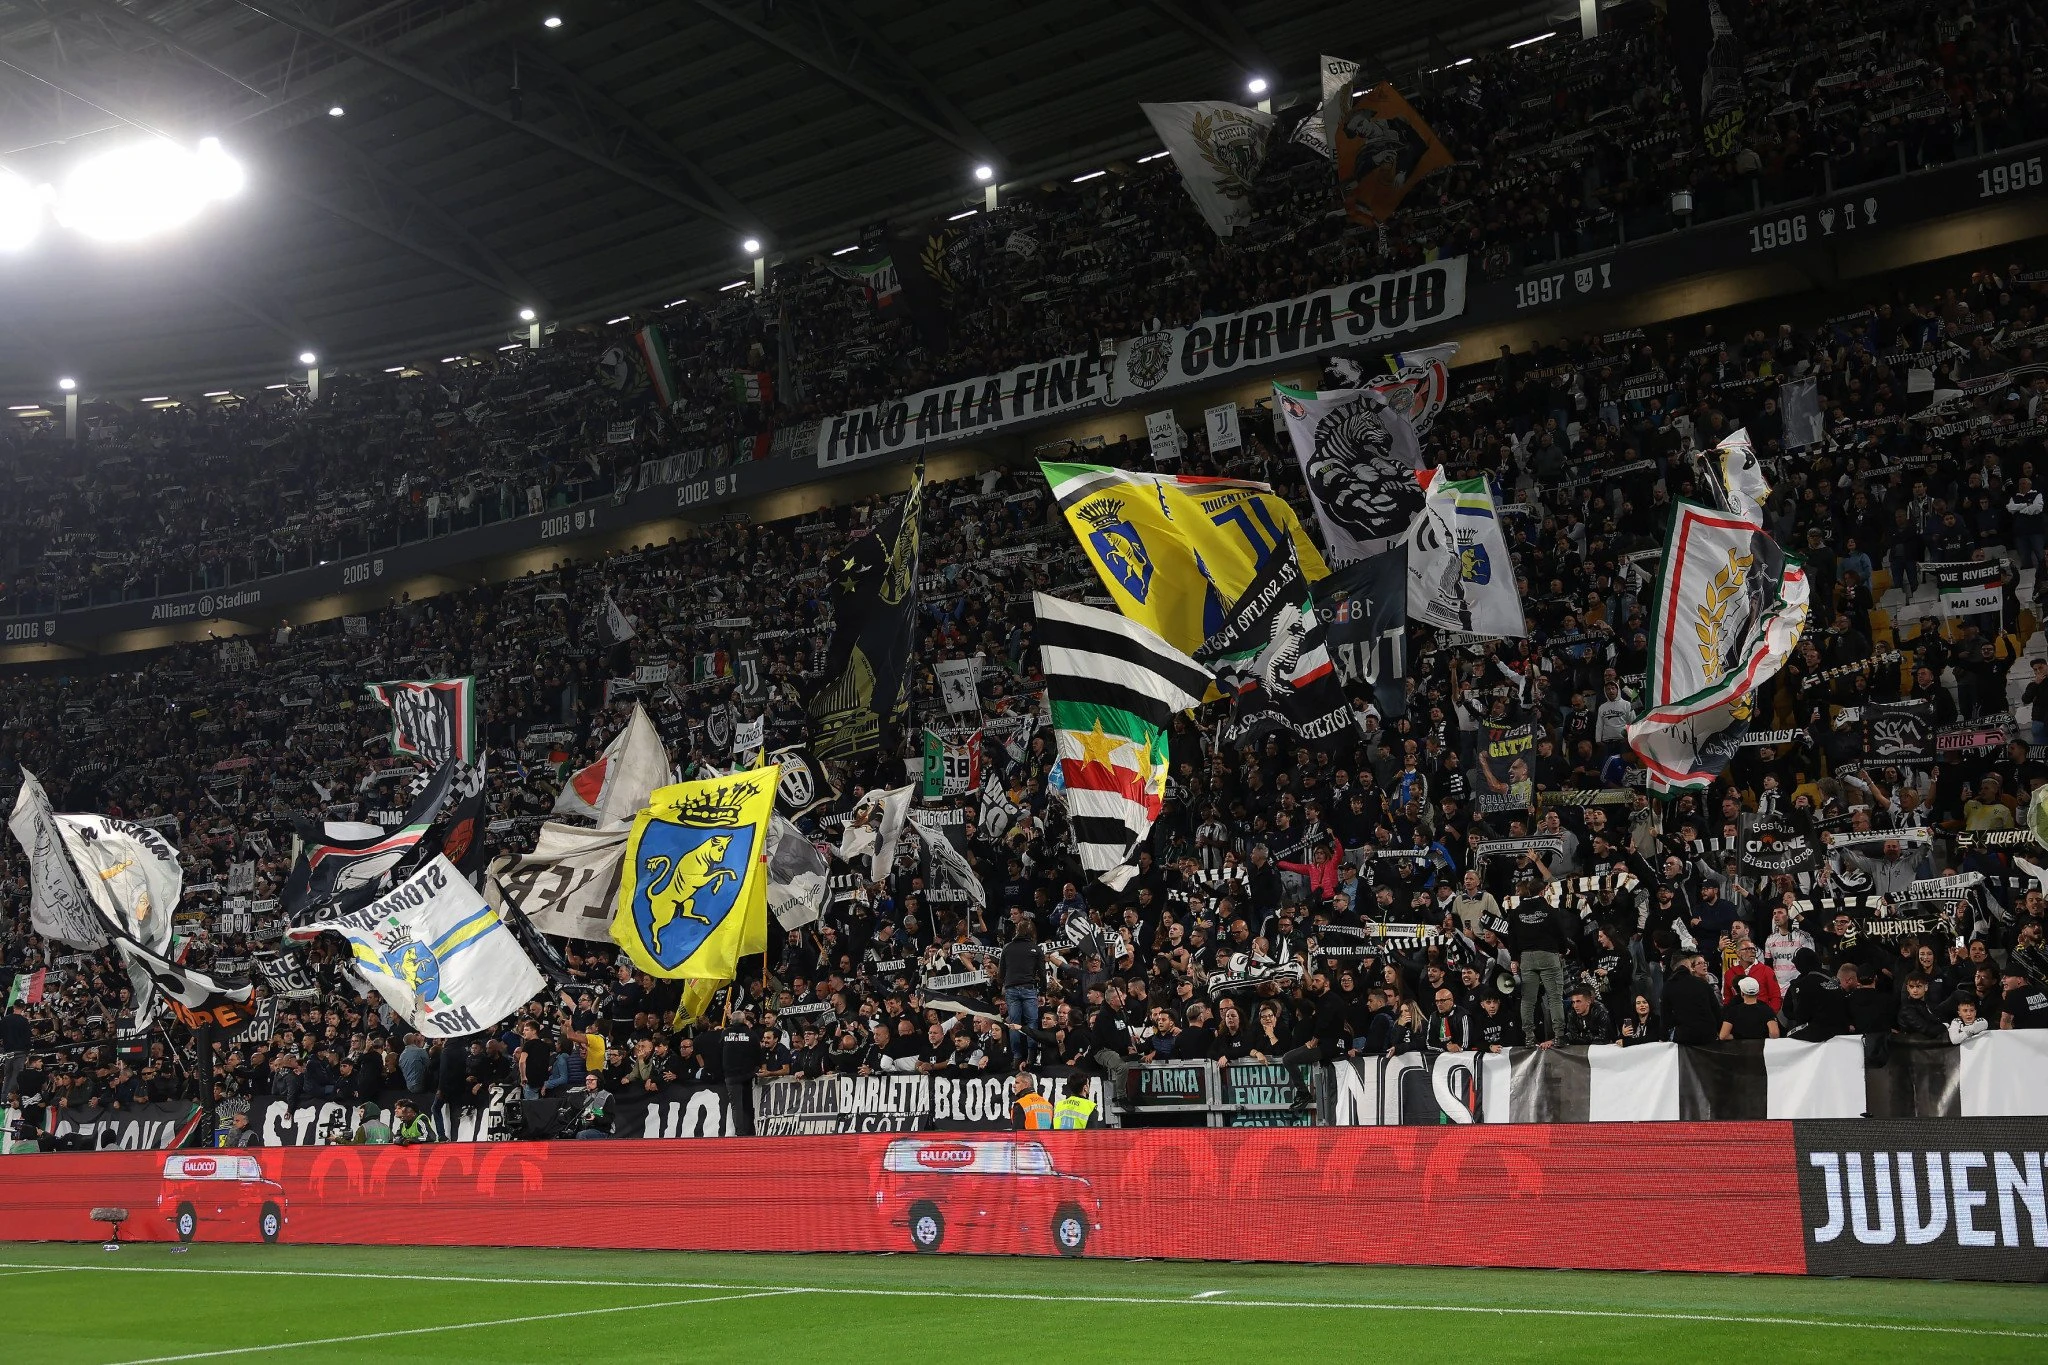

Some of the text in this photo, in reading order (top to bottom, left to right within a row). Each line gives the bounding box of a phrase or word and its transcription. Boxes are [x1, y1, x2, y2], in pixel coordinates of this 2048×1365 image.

[1978, 157, 2043, 198] 1995
[1750, 215, 1807, 252] 1996
[1515, 274, 1565, 309] 1997
[1577, 274, 1591, 288] 24
[1181, 294, 1335, 376] CURVA
[1347, 268, 1447, 336] SUD
[827, 402, 907, 461] FINO
[916, 378, 1003, 440] ALLA
[1013, 351, 1101, 417] FINE
[677, 480, 709, 507] 2002
[542, 514, 569, 539] 2003
[343, 561, 370, 585] 2005
[1940, 565, 2001, 583] DUE RIVIERE
[151, 588, 261, 621] Allianz Stadium
[1951, 595, 1999, 609] MAI SOLA
[6, 623, 39, 641] 2006
[1488, 734, 1533, 758] GATTI
[1752, 821, 1796, 835] Sestola
[1485, 838, 1556, 852] MICHEL PLATINI
[1743, 846, 1814, 871] Bianconera
[1865, 918, 1926, 935] JUVENTUS
[1141, 1068, 1200, 1094] PARMA
[759, 1079, 838, 1117] ANDRIA
[839, 1074, 931, 1114] BARLETTA
[183, 1161, 216, 1172] BALOCCO
[919, 1149, 973, 1163] BALOCCO
